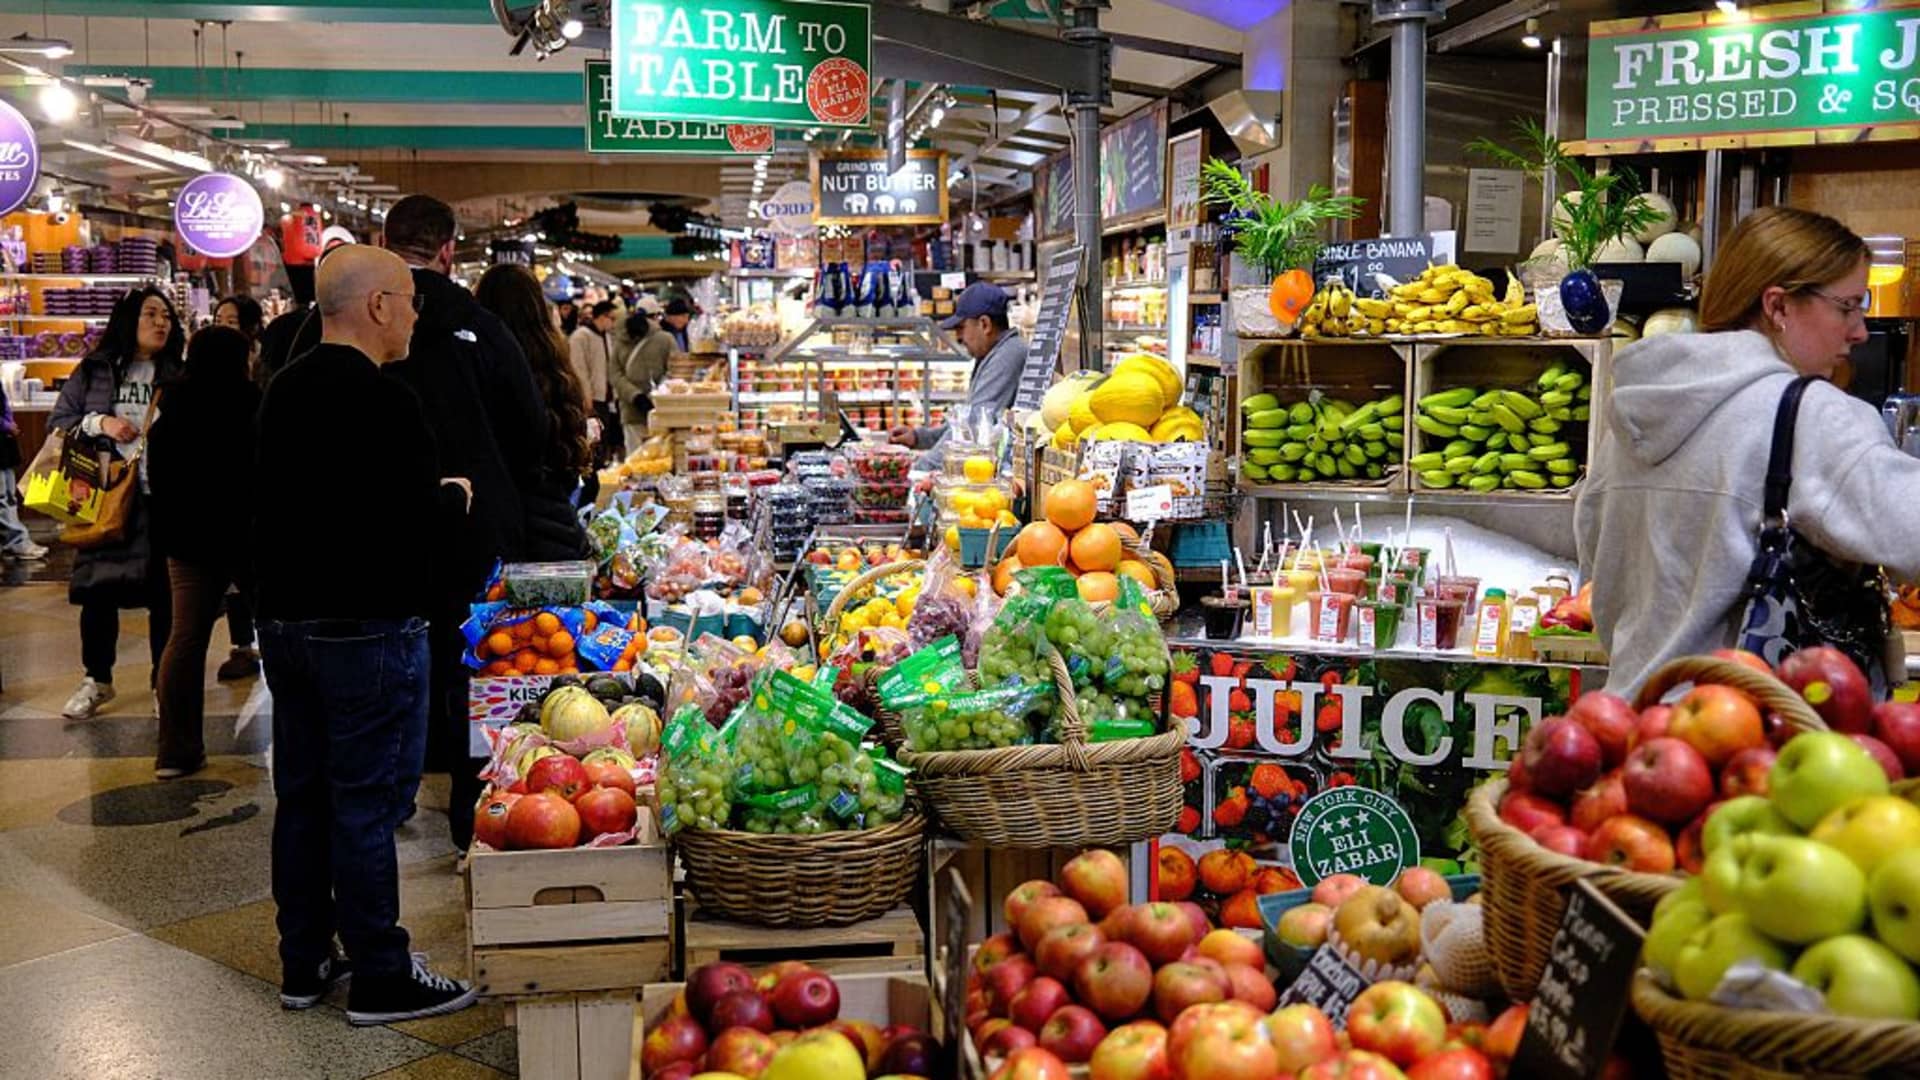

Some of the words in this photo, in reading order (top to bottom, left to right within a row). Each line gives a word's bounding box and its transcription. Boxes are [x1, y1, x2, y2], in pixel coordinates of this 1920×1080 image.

[631, 5, 786, 54] FARM
[798, 22, 846, 54] TO
[1612, 23, 1862, 89] FRESH
[629, 53, 804, 104] TABLE
[1611, 87, 1797, 127] PRESSED
[1817, 83, 1851, 114] &
[598, 111, 724, 140] TABLE
[823, 175, 862, 192] NUT
[837, 163, 868, 172] GRIND
[1366, 241, 1427, 260] BANANA
[1186, 675, 1543, 770] JUICE
[1295, 810, 1316, 842] NEW
[1315, 790, 1358, 810] YORK
[1363, 794, 1399, 818] CITY
[1317, 843, 1398, 877] ZABAR
[1329, 828, 1372, 855] ELI
